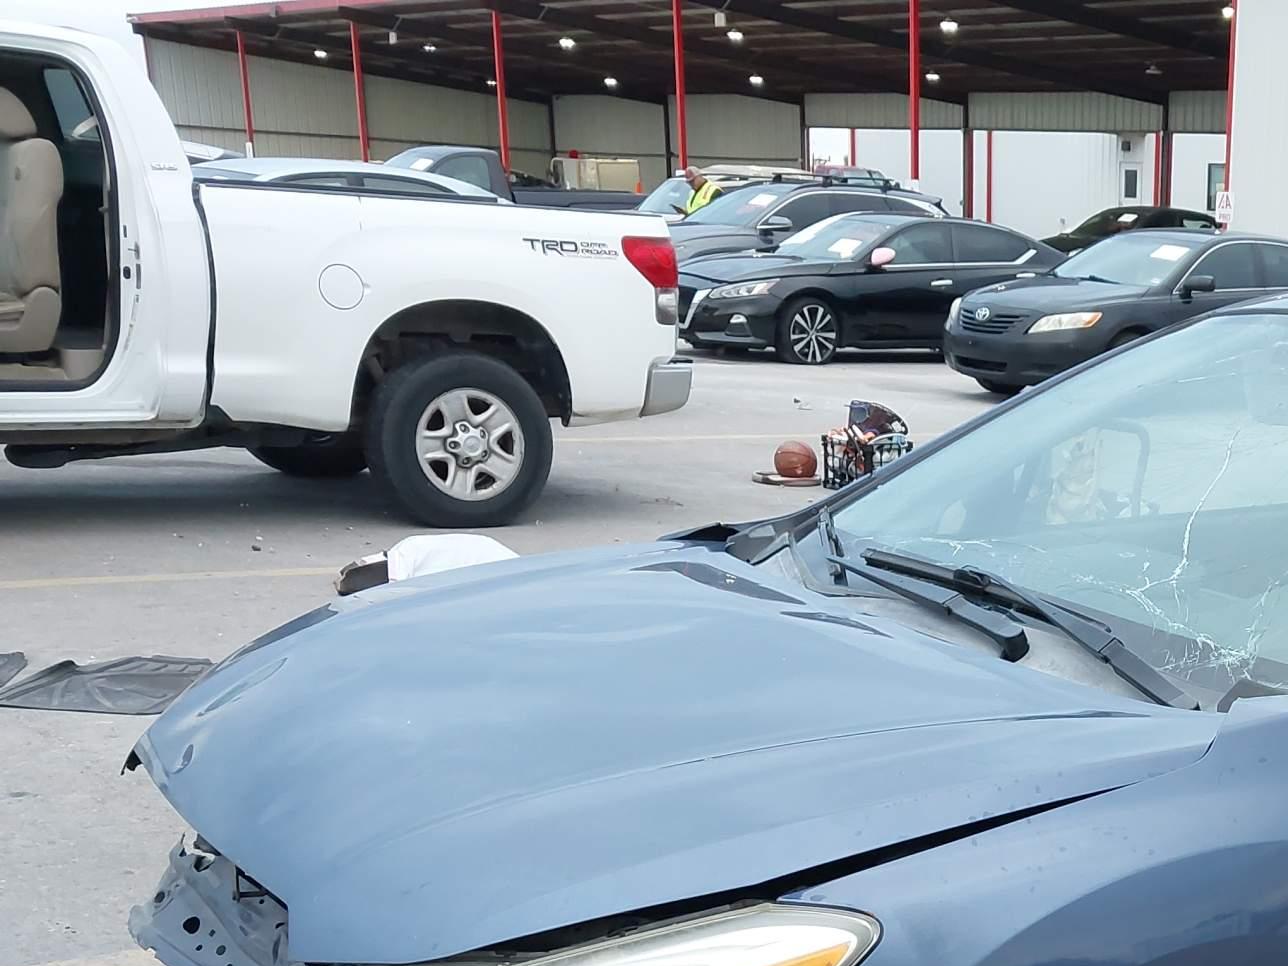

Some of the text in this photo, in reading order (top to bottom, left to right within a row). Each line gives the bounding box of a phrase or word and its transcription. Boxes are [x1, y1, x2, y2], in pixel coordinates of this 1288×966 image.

[521, 237, 579, 257] TRD
[580, 241, 609, 249] OFF
[581, 248, 619, 257] ROAD
